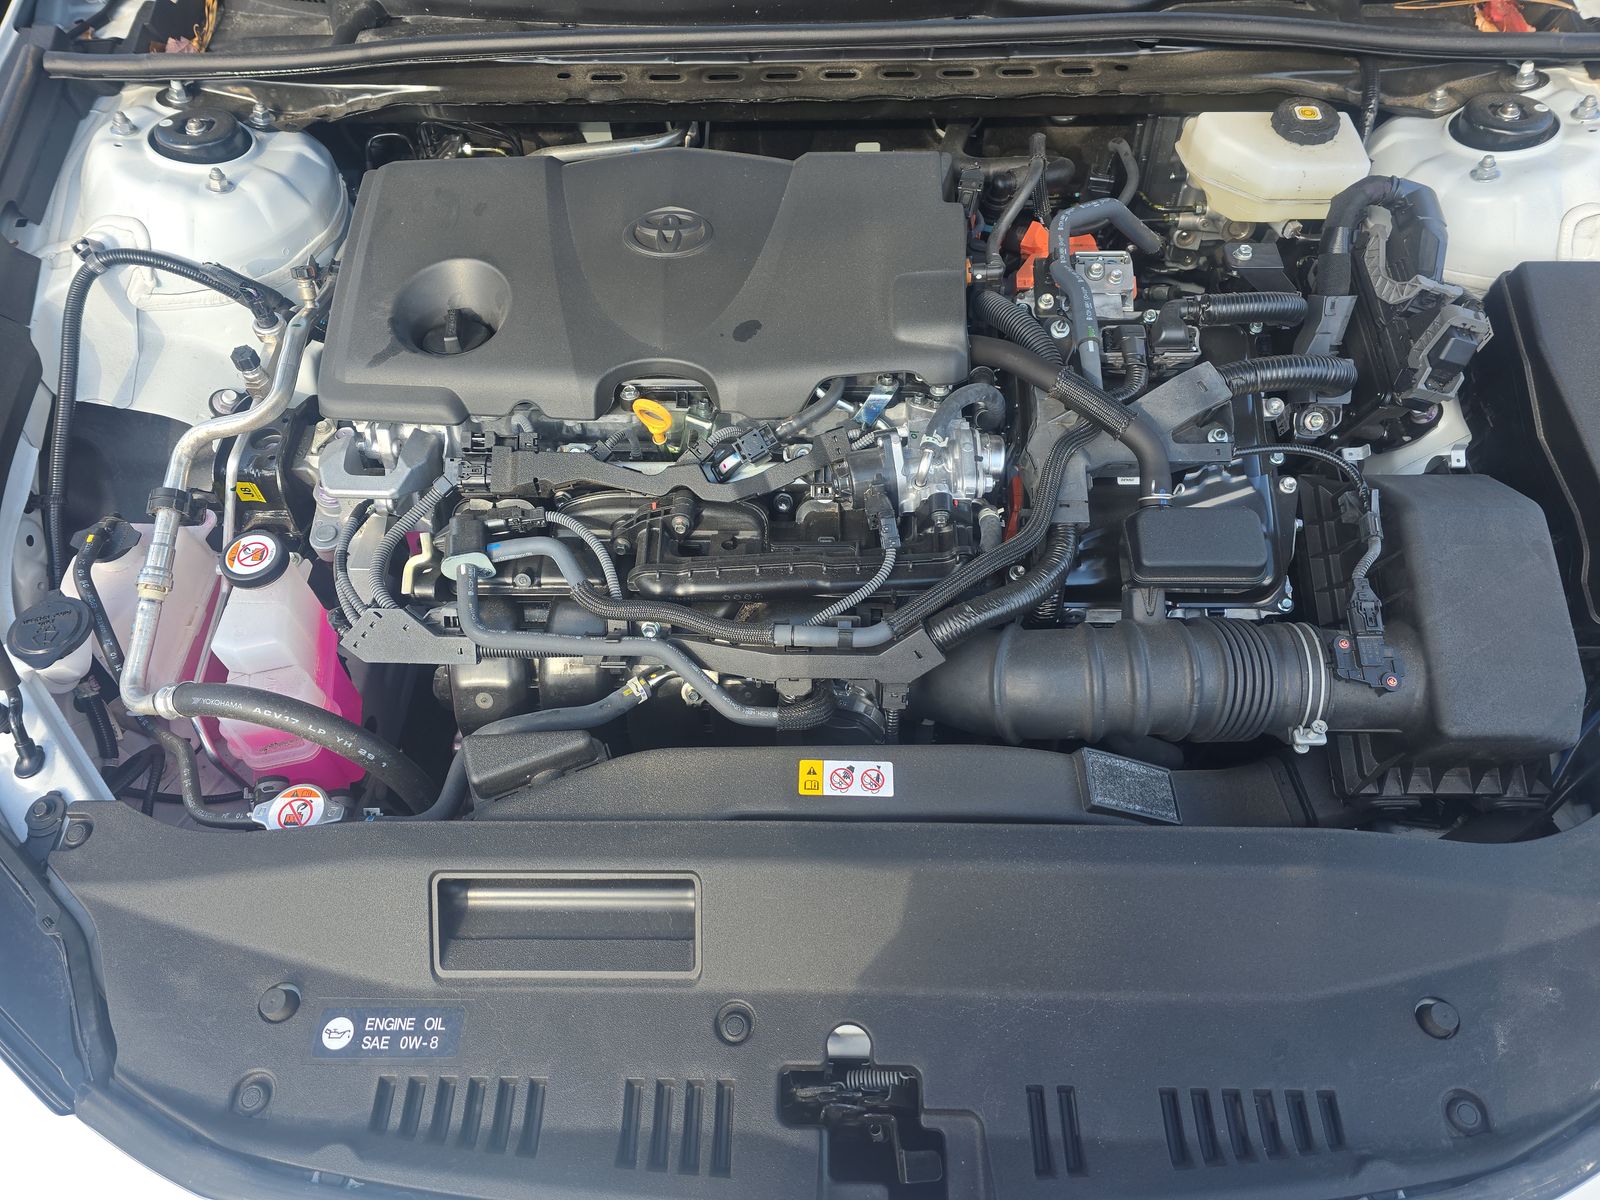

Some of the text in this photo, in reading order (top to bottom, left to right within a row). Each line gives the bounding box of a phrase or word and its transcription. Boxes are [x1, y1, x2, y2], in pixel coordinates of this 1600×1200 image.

[200, 697, 243, 710] YOKOHAMA
[252, 706, 300, 724] ACV17
[307, 724, 327, 736] LP
[336, 735, 354, 749] YH
[358, 748, 376, 761] 29
[364, 1017, 446, 1031] ENGINE OIL
[361, 1036, 439, 1050] SAE 0W-8
